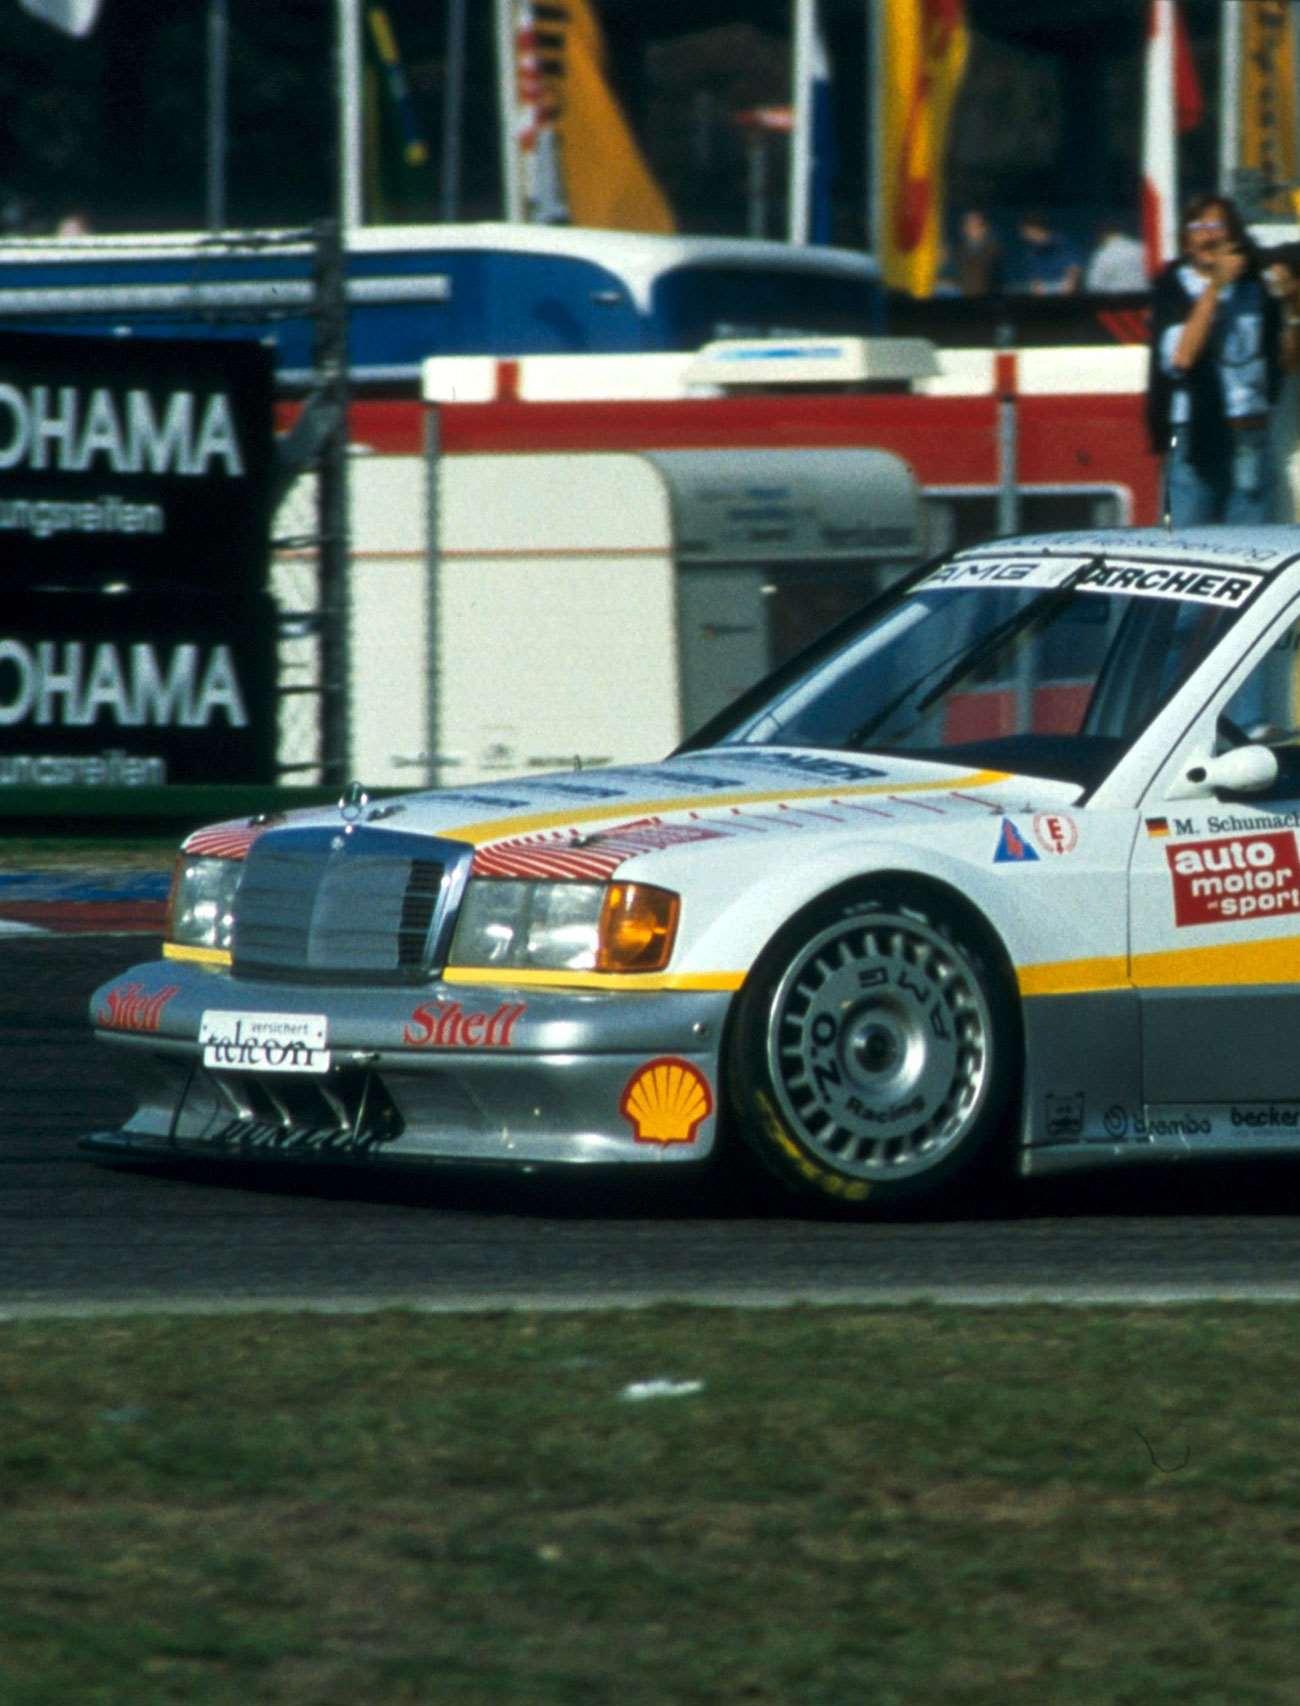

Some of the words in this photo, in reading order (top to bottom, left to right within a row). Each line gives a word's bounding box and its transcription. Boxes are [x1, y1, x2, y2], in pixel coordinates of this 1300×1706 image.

[930, 563, 1040, 582] AMG
[1175, 819, 1200, 835] M.
[1174, 840, 1275, 875] auto
[1192, 868, 1293, 897] motor
[402, 1000, 529, 1047] Shell
[1231, 1104, 1300, 1127] becker
